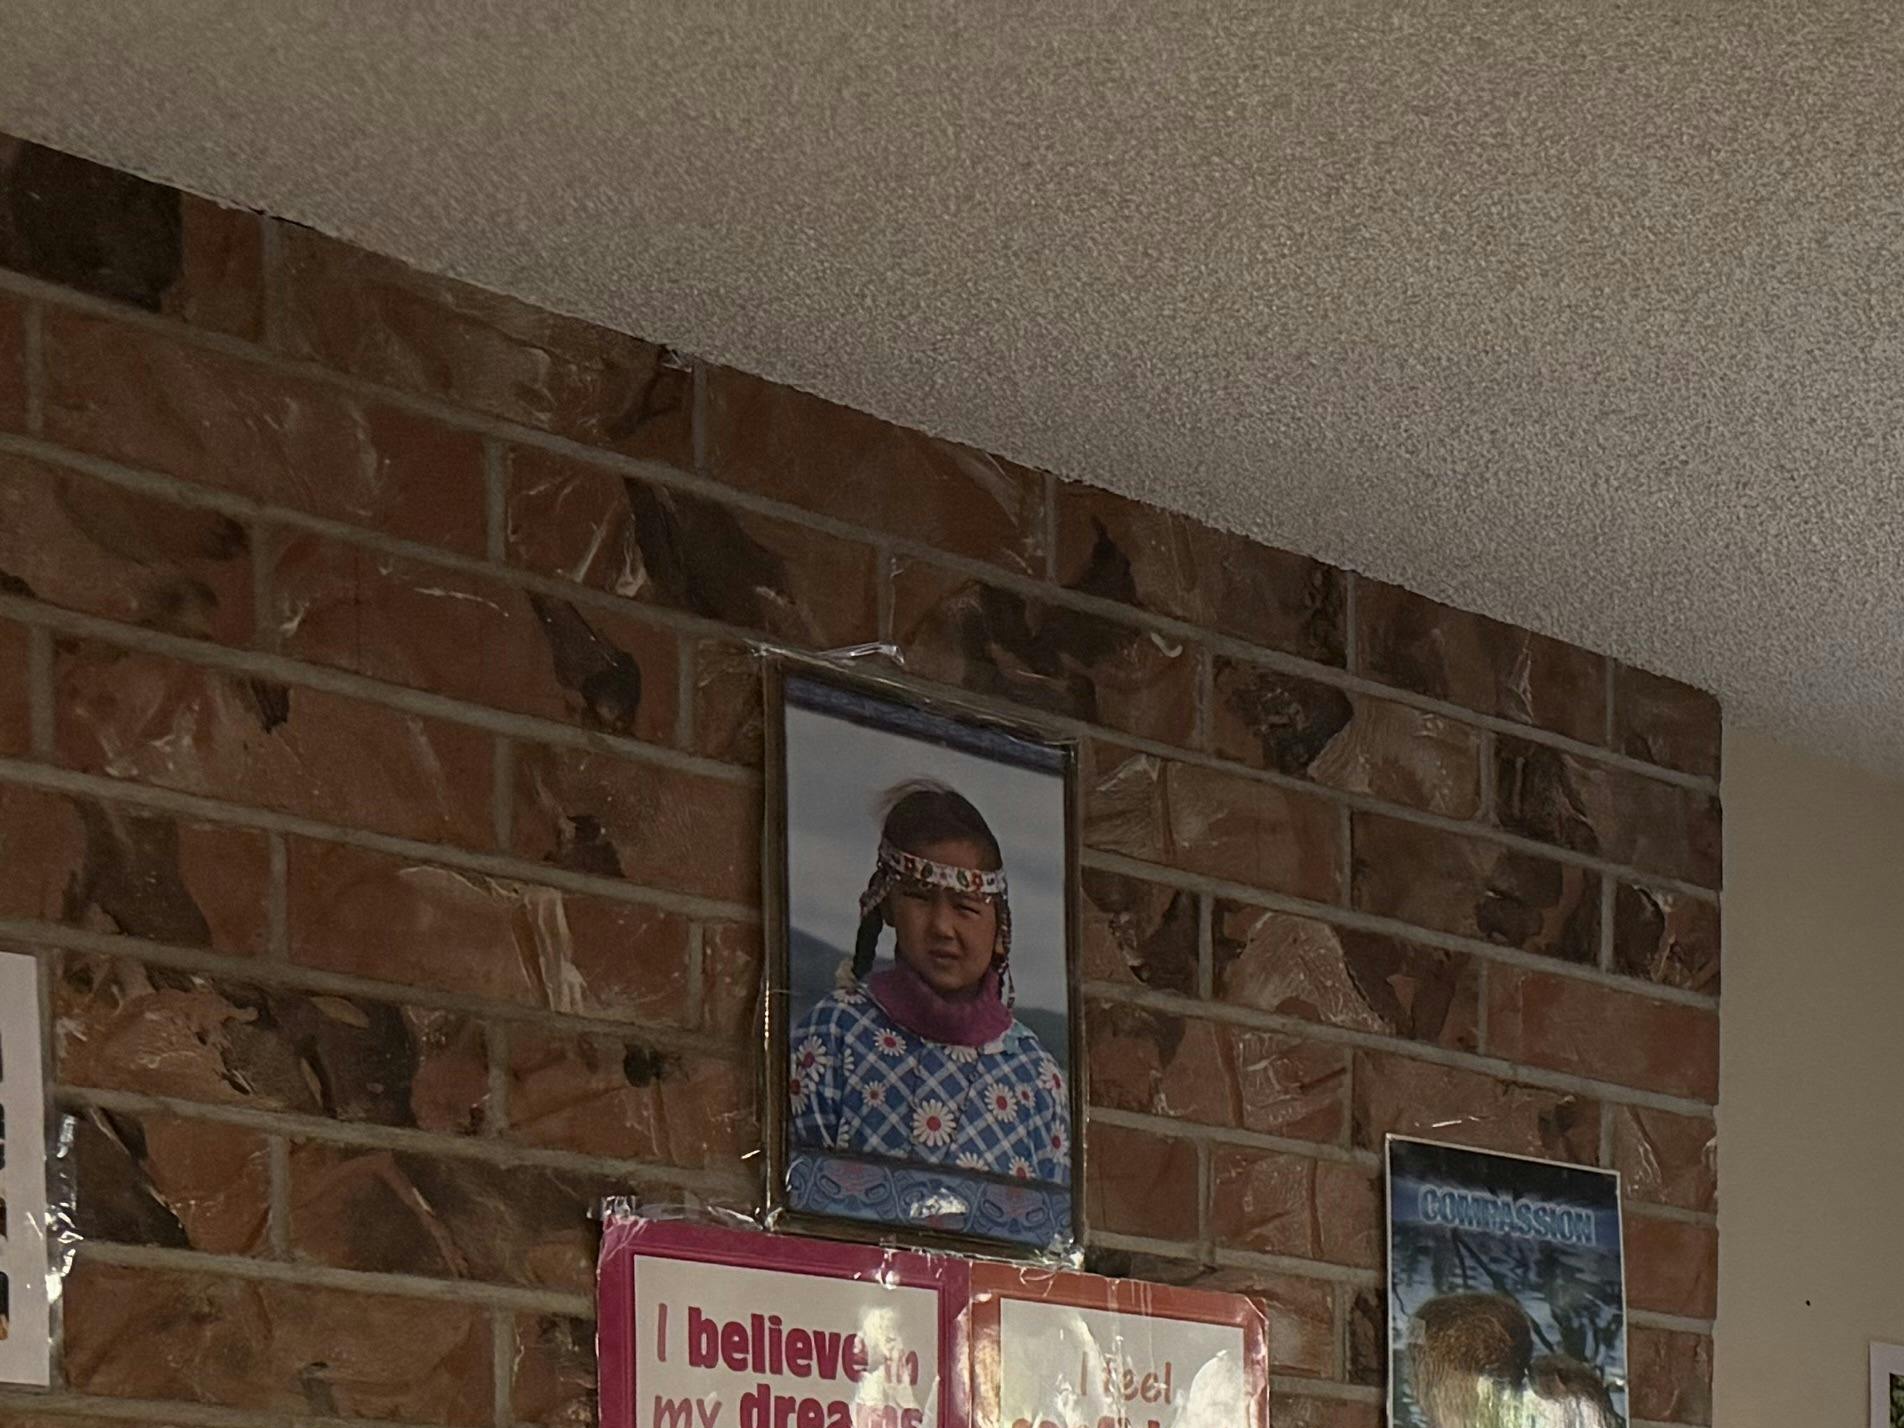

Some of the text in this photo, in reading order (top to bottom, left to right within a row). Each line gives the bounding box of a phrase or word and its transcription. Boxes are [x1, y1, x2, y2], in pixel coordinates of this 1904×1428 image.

[1419, 1185, 1595, 1246] COMPASSION
[656, 1302, 668, 1363] I
[687, 1305, 869, 1383] believe
